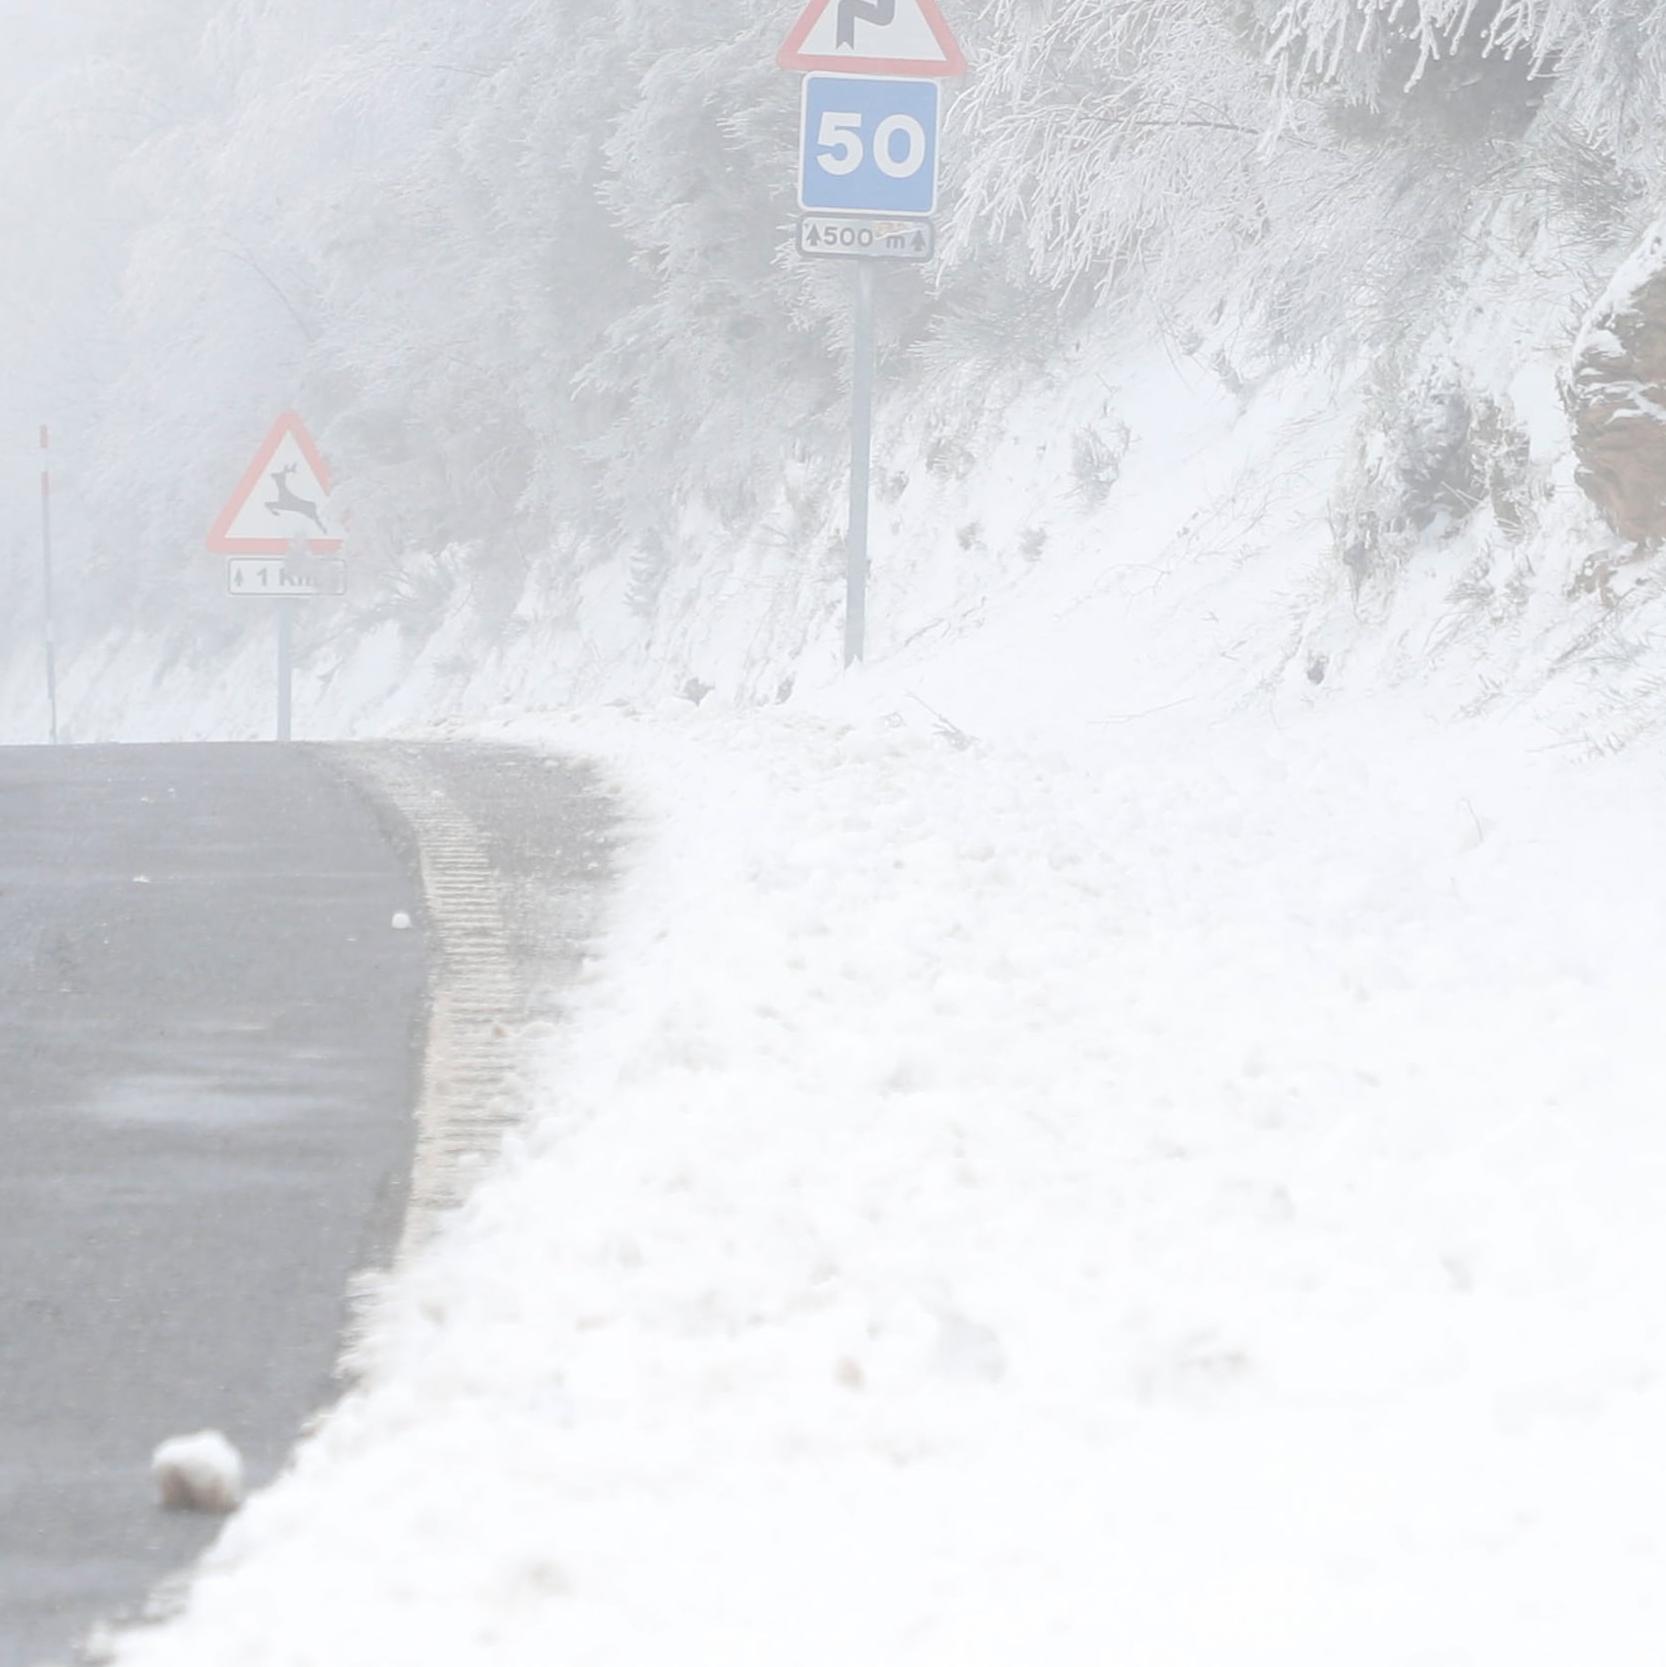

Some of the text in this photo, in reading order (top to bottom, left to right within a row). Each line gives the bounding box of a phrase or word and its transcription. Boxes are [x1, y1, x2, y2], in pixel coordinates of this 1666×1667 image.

[816, 111, 926, 179] 50
[823, 226, 906, 250] 500 m
[256, 566, 268, 587] 1
